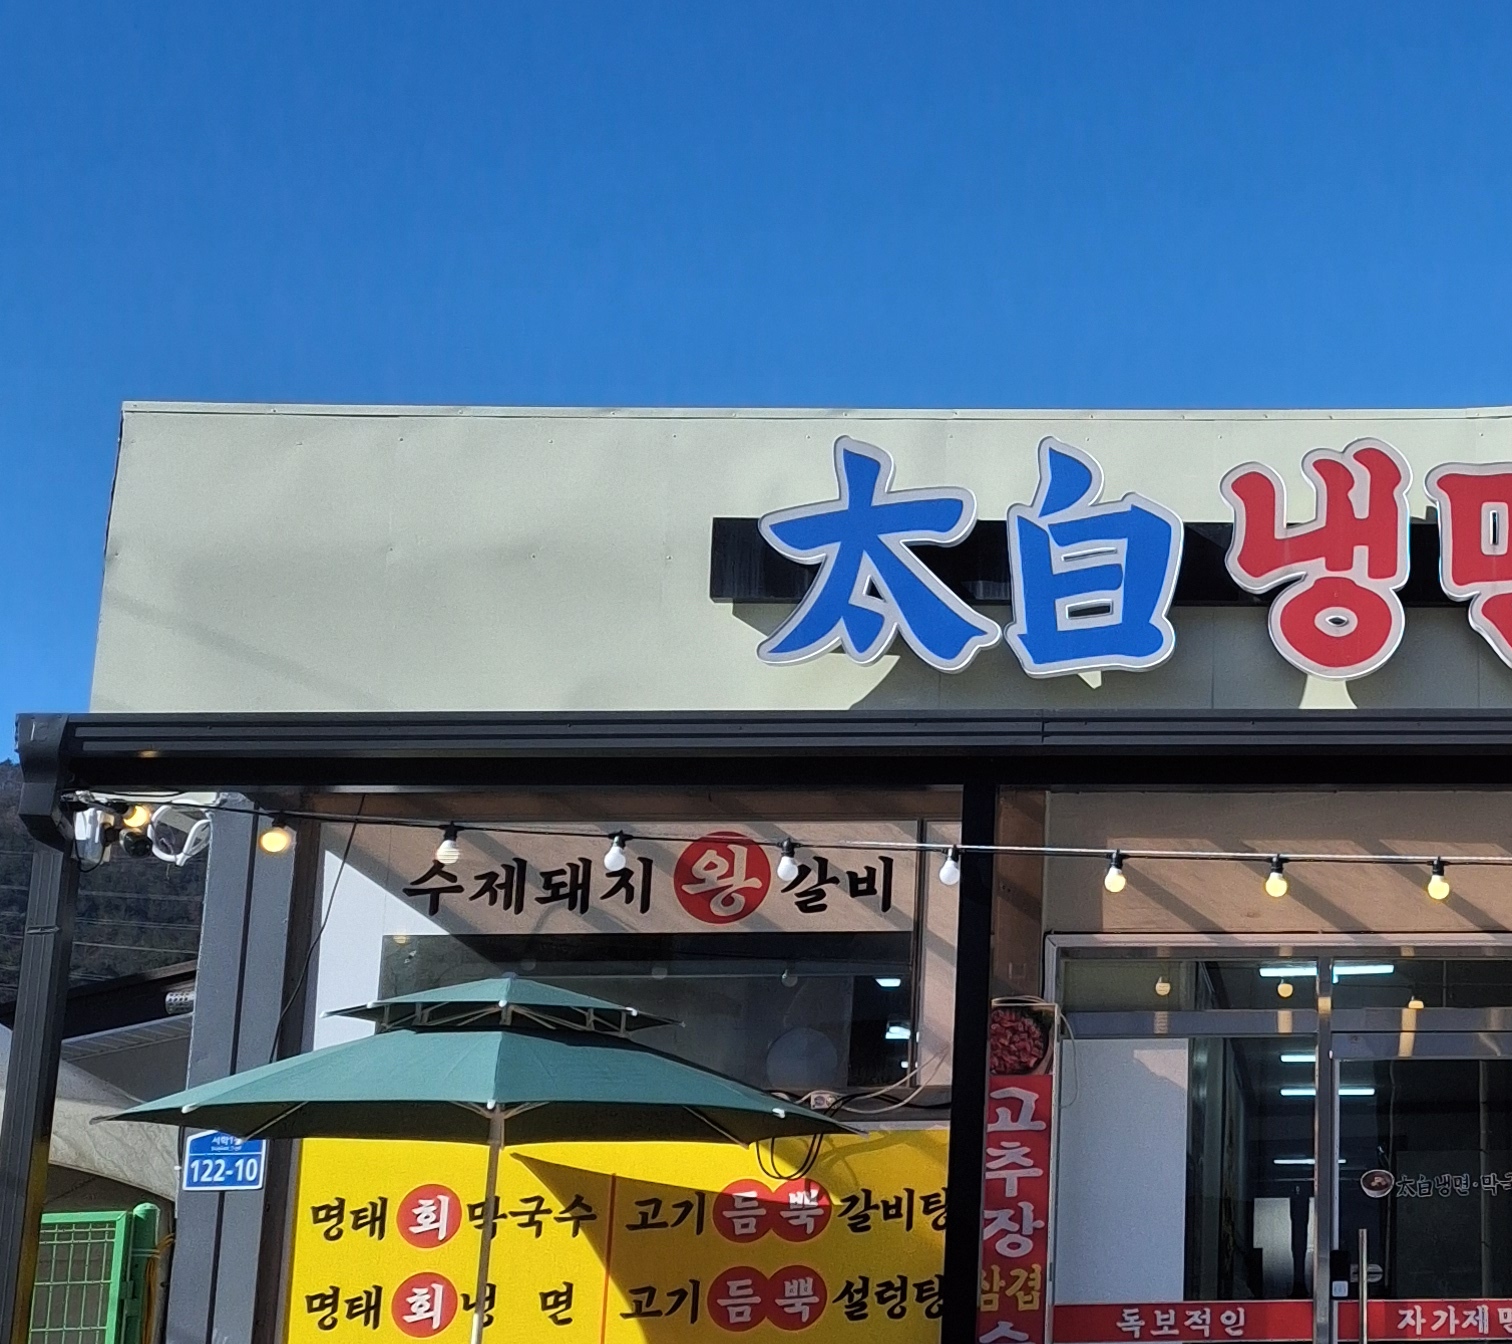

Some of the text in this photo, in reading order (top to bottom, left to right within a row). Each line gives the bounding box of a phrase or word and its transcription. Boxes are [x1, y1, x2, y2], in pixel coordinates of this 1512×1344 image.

[757, 435, 1184, 676] 太白
[190, 1158, 258, 1183] 122-10
[1116, 1307, 1246, 1338] 독보적인
